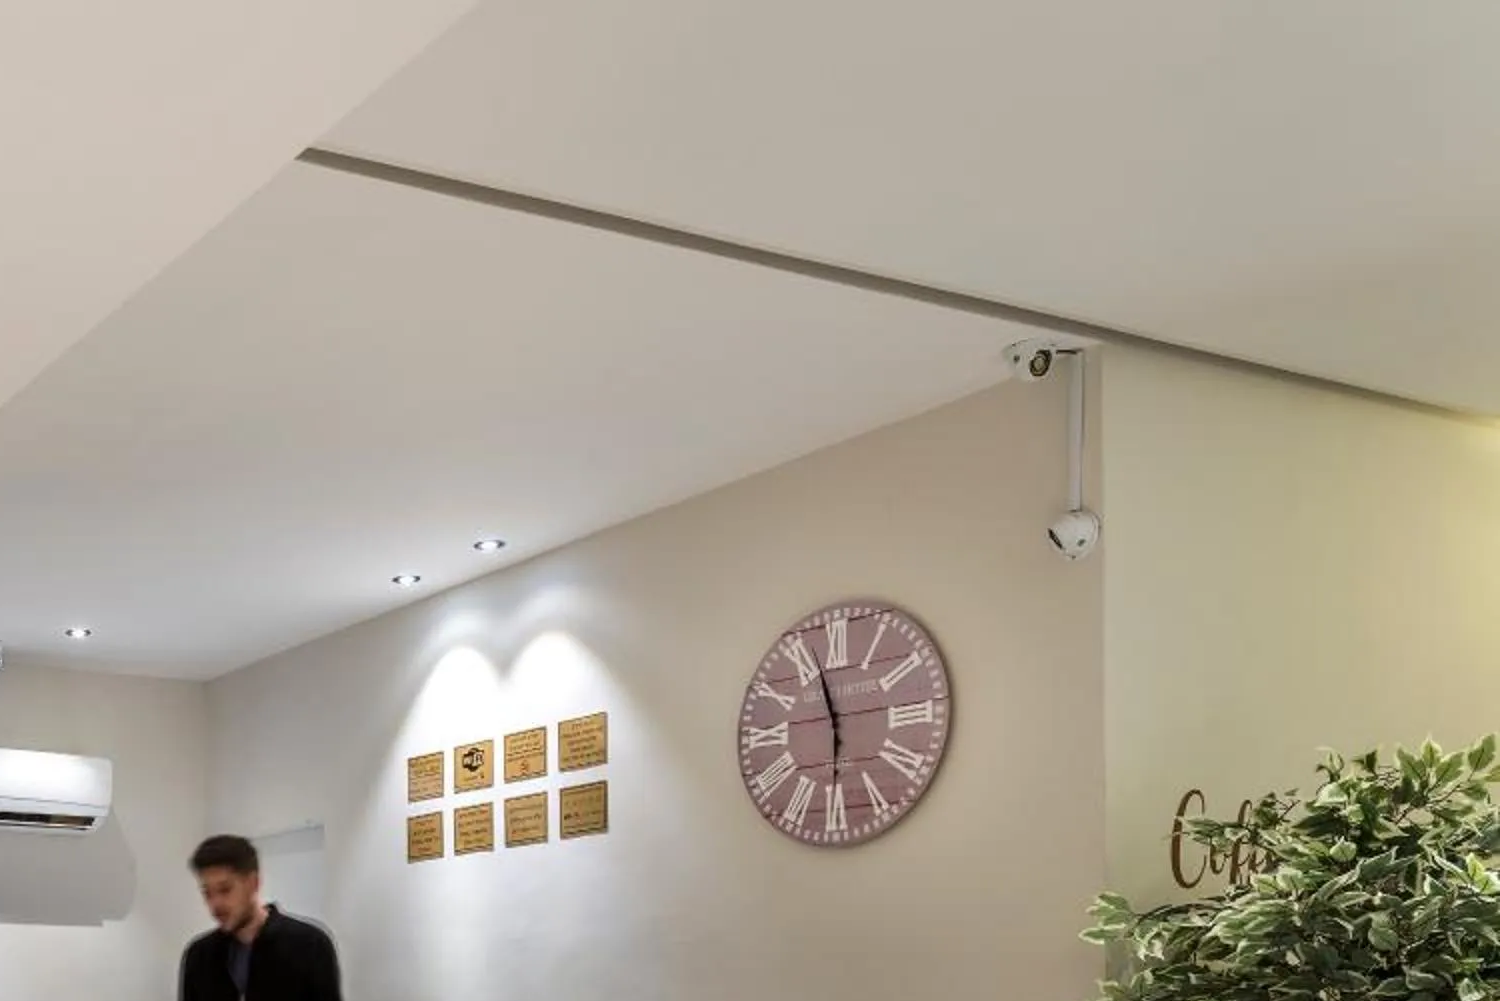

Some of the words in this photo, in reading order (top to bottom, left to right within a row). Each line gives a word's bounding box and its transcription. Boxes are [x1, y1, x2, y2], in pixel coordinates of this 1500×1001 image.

[784, 638, 820, 688] XI
[825, 618, 848, 669] XII
[879, 651, 922, 692] II
[753, 682, 796, 711] X
[888, 700, 933, 729] III
[749, 721, 789, 749] IX
[756, 751, 797, 803] VIII
[862, 771, 890, 817] V
[783, 774, 817, 827] VII
